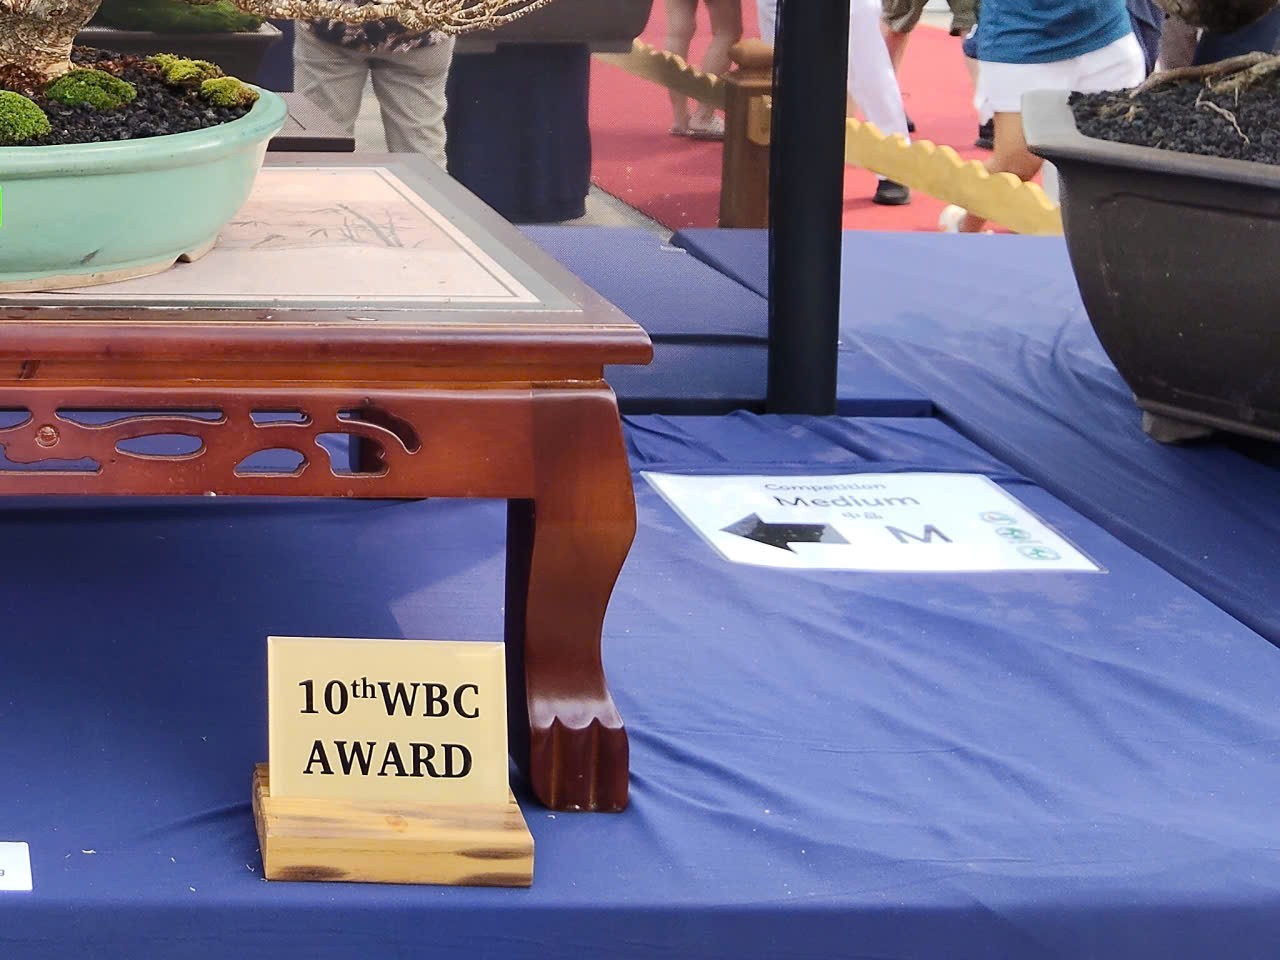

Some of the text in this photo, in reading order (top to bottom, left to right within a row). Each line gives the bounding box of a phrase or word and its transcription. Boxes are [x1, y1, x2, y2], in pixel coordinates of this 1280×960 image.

[764, 483, 887, 493] Competition
[772, 495, 921, 507] Medium
[885, 524, 954, 544] M
[303, 740, 473, 778] AWARD
